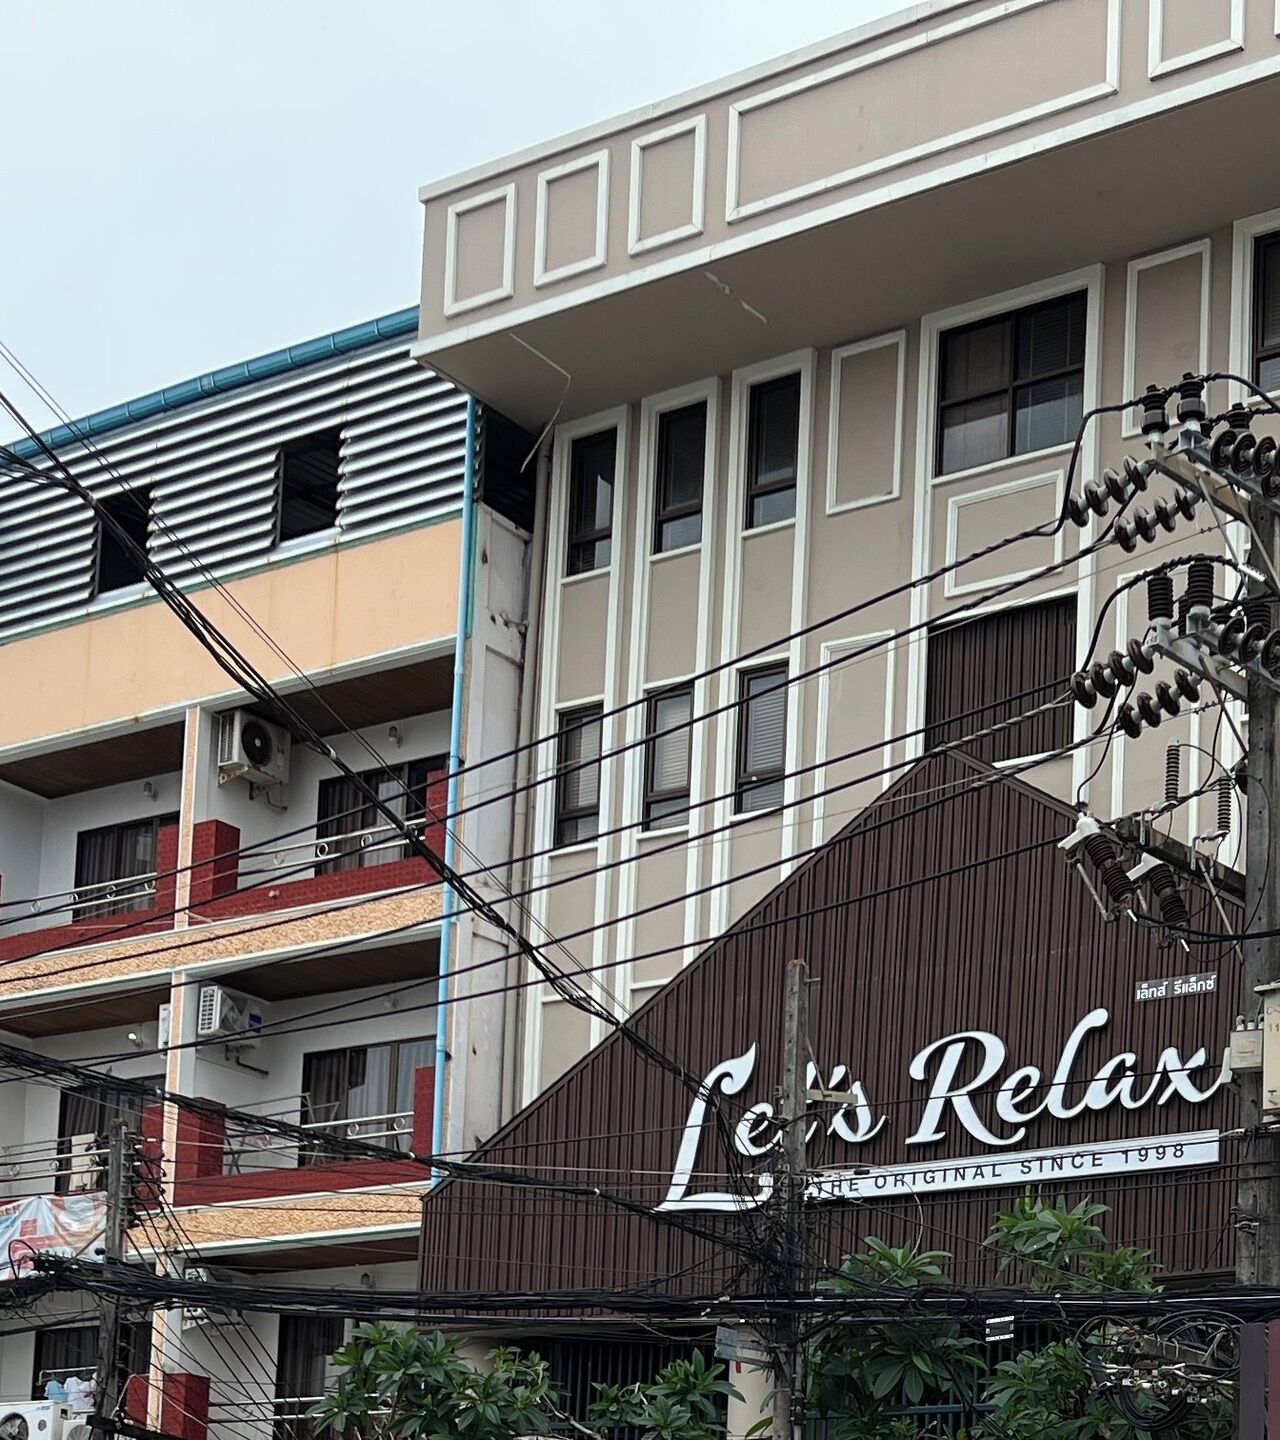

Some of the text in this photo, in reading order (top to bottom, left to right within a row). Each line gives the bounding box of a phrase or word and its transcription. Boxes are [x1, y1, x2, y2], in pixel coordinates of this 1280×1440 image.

[653, 1007, 1232, 1212] Le's Relax
[874, 1163, 1002, 1189] ORIGINAL
[1020, 1151, 1104, 1175] SINCE
[1122, 1143, 1185, 1165] 1998
